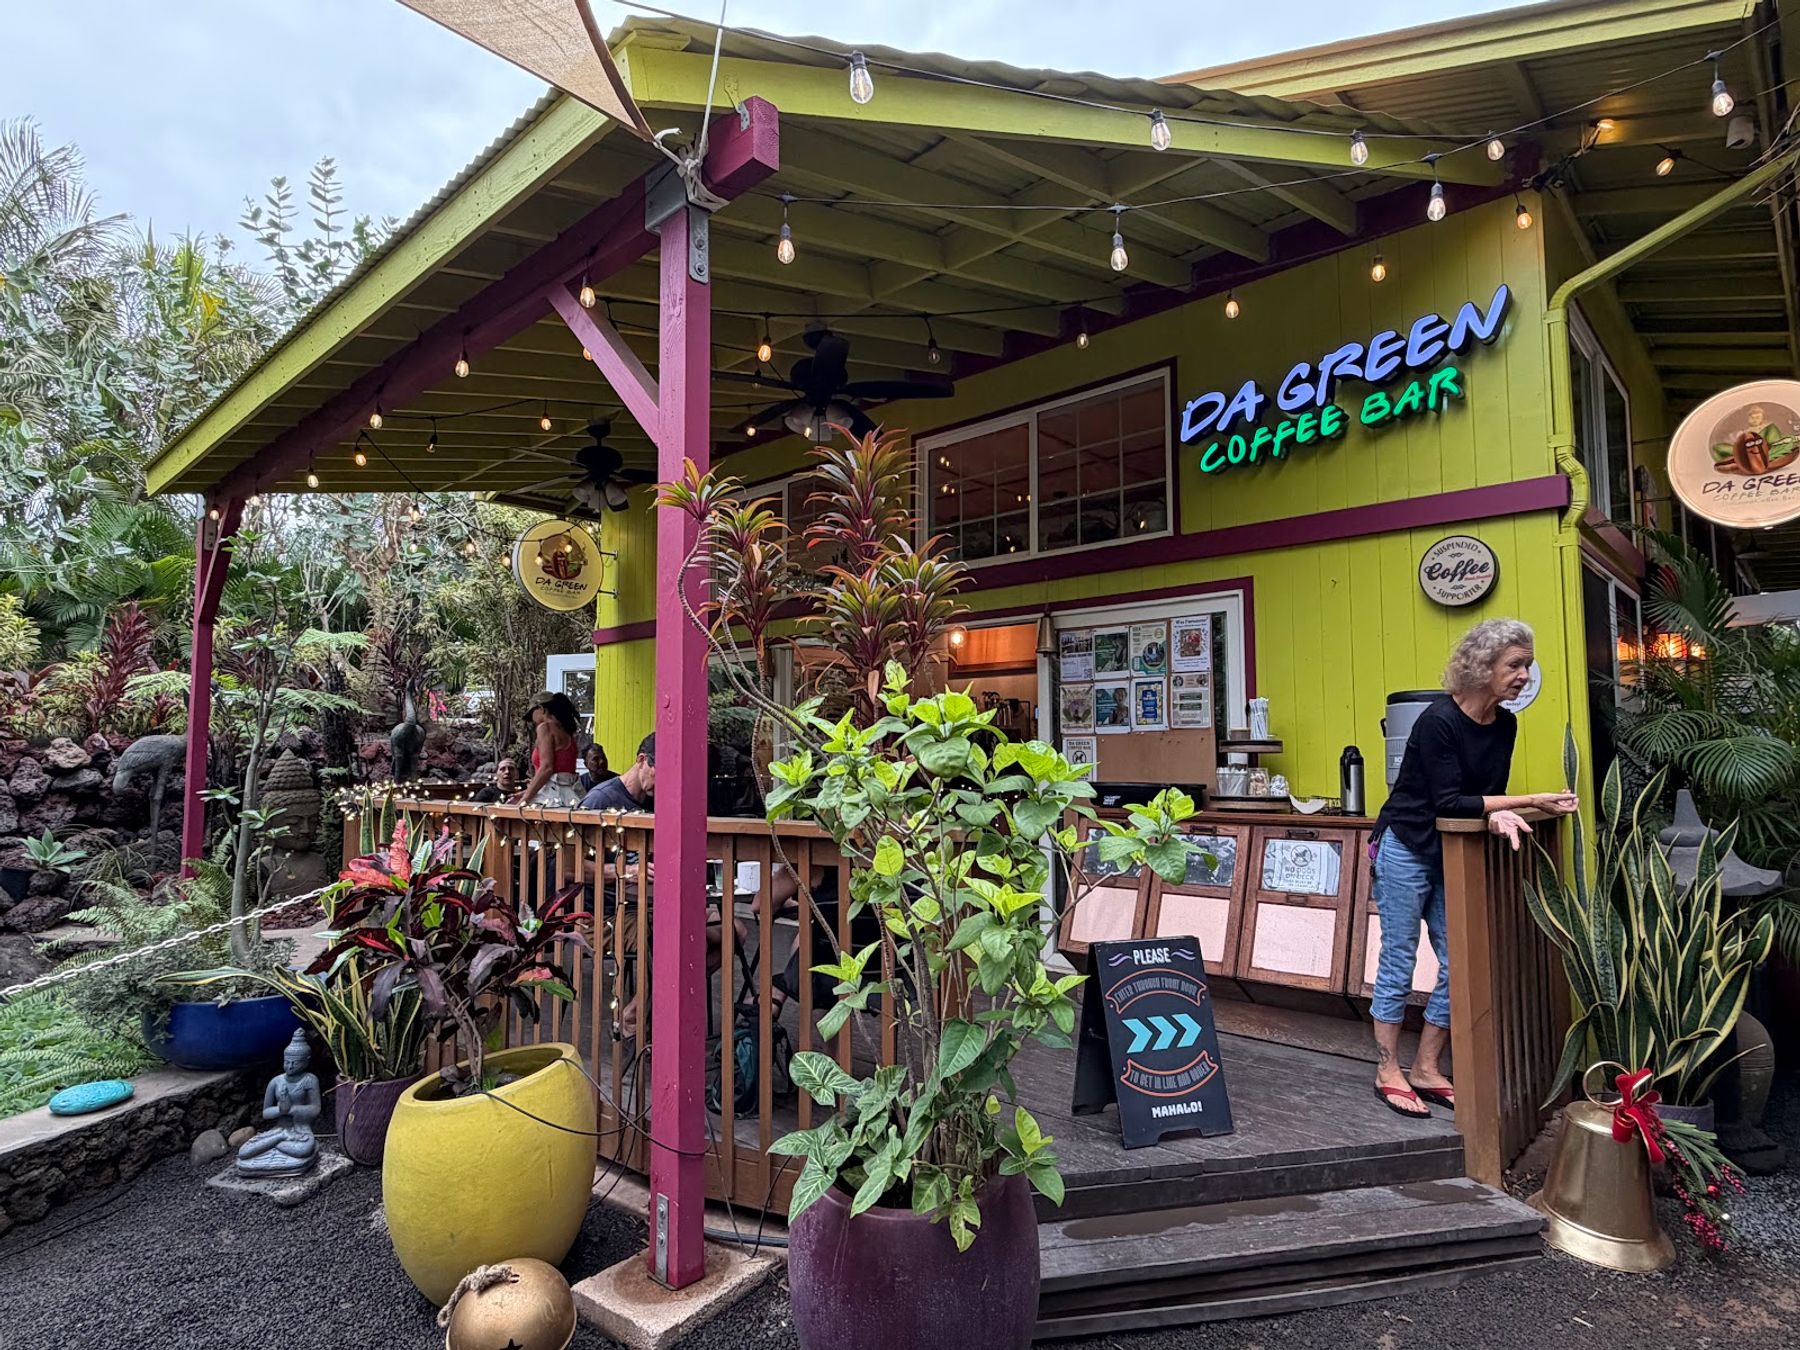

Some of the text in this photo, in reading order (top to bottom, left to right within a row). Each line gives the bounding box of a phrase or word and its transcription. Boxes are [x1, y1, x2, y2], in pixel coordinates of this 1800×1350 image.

[1180, 283, 1510, 443] DA GREEN
[1199, 366, 1463, 474] COFFEE BAR
[1702, 473, 1800, 494] DA GREE
[1713, 490, 1764, 502] COFFEE
[1433, 541, 1479, 557] SUSPENDED
[1423, 558, 1490, 583] Coffee
[536, 577, 588, 590] DA GREEN
[1436, 583, 1482, 601] SUPPORTER
[1296, 867, 1316, 875] DOGS
[1133, 948, 1172, 965] PLEASE
[1113, 977, 1199, 1002] ENTER THROUGH FRONT DOOR
[1129, 1060, 1211, 1090] TO GET IN LINE AND ORDER
[1151, 1101, 1203, 1119] MAHALO!
